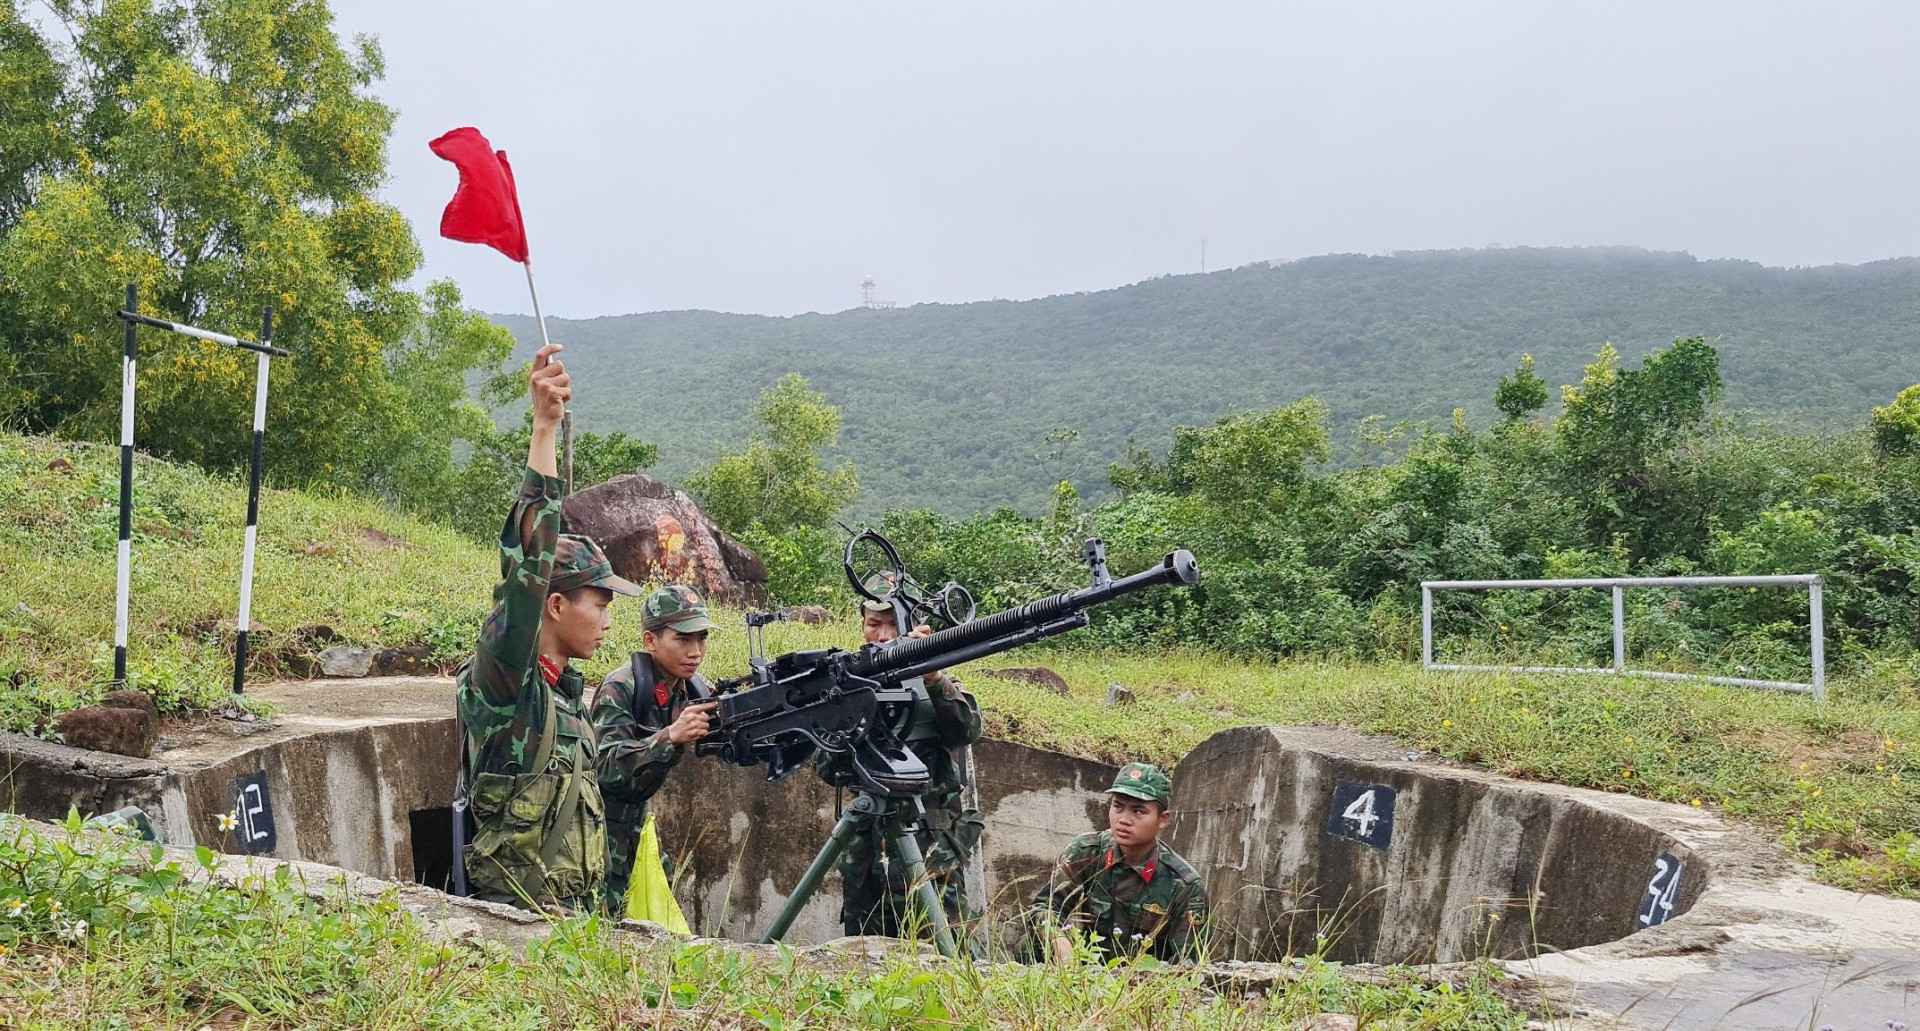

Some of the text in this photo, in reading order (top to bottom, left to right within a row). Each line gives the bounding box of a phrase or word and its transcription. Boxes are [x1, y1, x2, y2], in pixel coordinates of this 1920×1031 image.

[236, 784, 268, 842] 12
[1341, 790, 1380, 837] 4
[1640, 859, 1682, 925] 24
